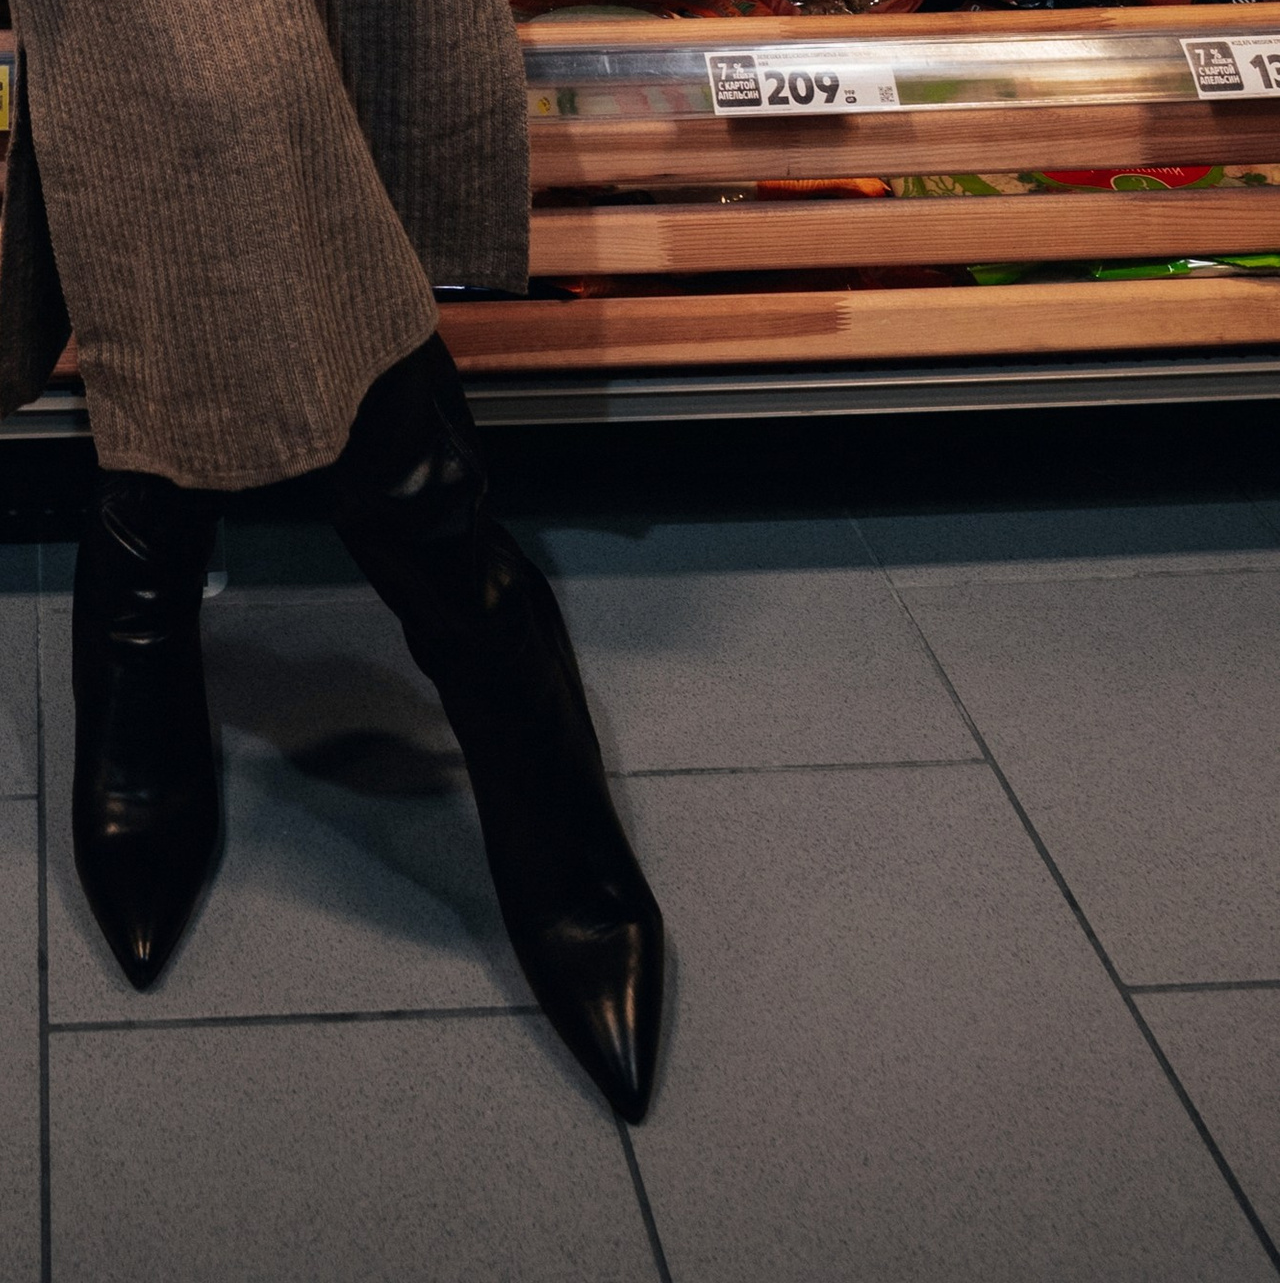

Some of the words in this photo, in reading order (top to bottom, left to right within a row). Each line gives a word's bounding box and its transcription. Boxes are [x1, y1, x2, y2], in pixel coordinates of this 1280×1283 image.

[1206, 64, 1235, 75] КАРТОЙ
[725, 79, 756, 90] КАРТОЙ
[1200, 75, 1240, 84] АПЕЛЬСИН
[764, 70, 840, 105] 209
[718, 90, 759, 100] АПЕЛЬСИН
